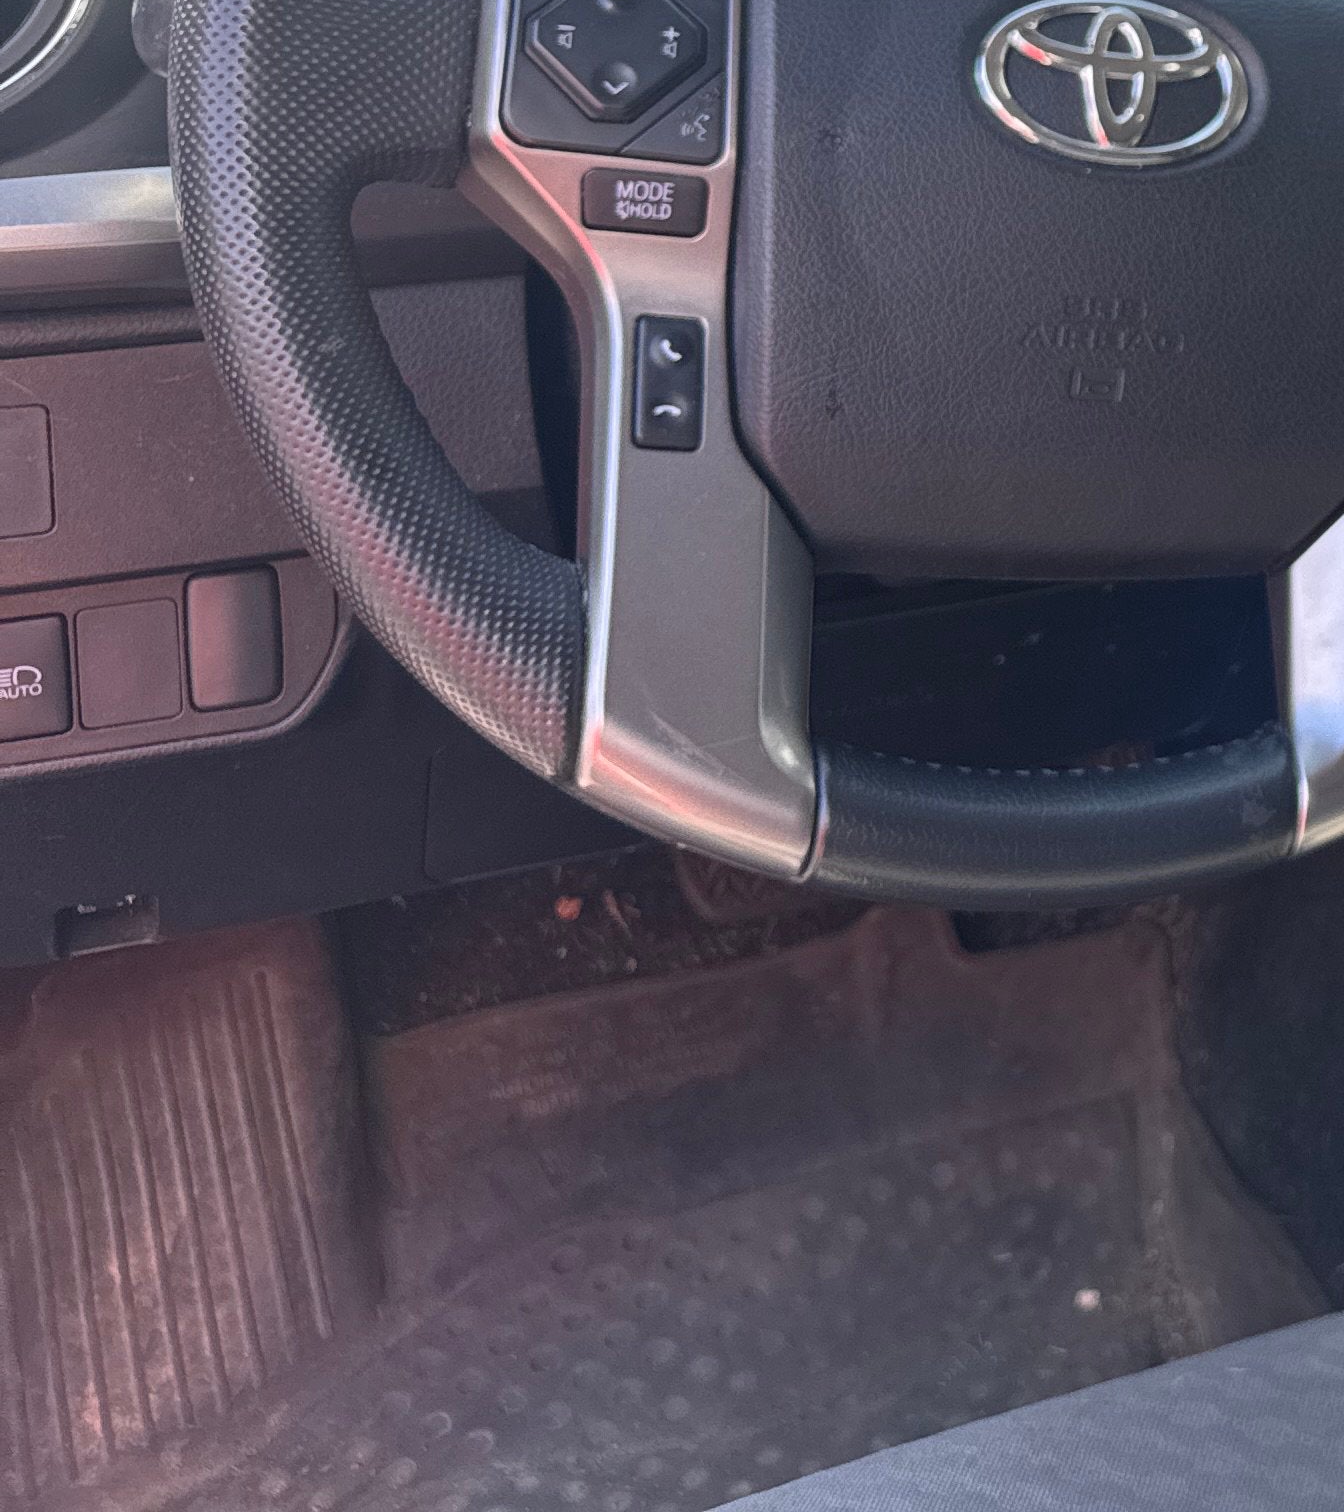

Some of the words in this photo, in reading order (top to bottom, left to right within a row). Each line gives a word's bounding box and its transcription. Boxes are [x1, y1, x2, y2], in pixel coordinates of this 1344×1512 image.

[615, 179, 676, 202] MODE
[629, 202, 672, 221] HOLD
[0, 683, 43, 701] AUTO
